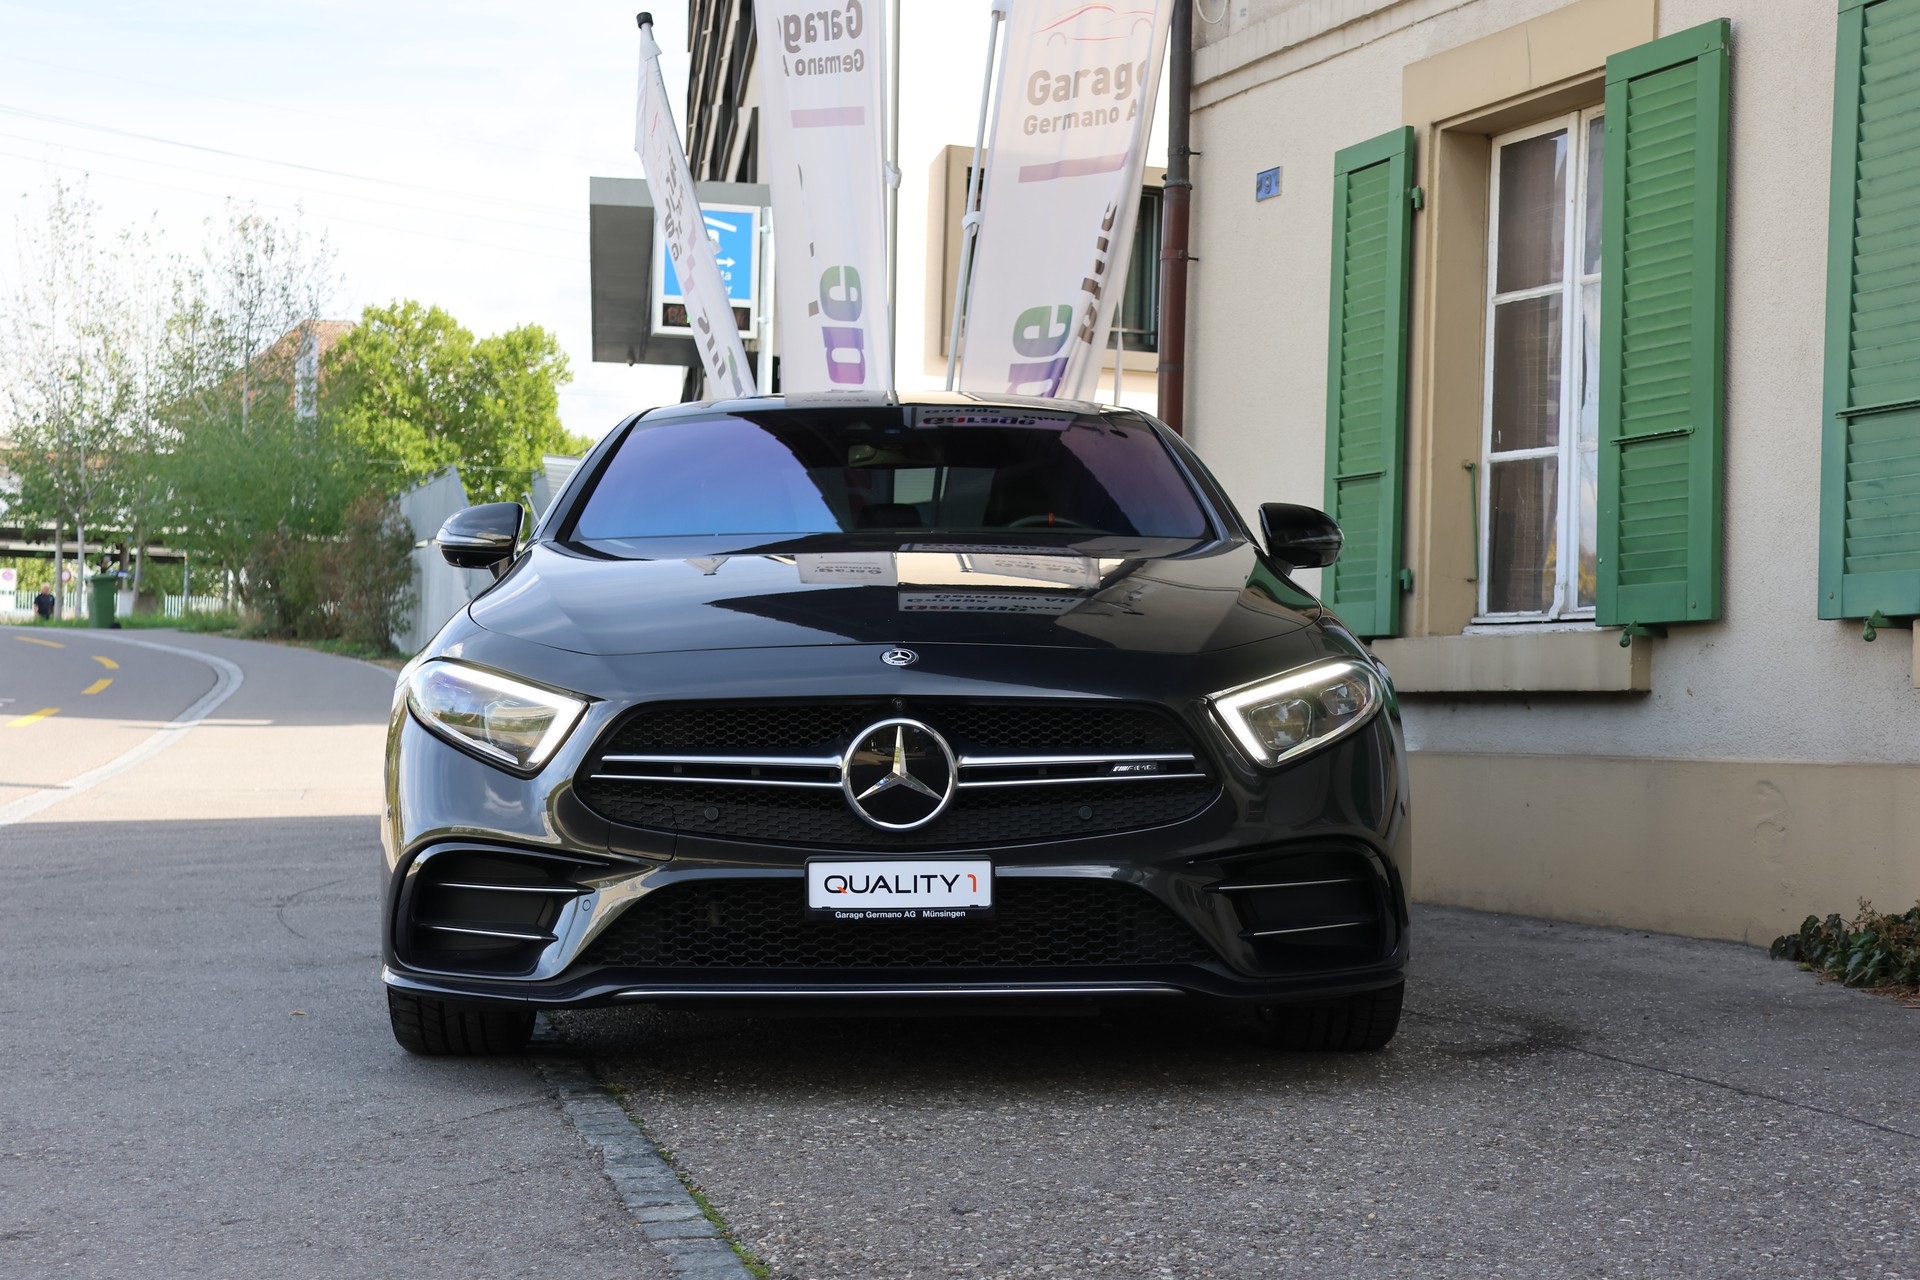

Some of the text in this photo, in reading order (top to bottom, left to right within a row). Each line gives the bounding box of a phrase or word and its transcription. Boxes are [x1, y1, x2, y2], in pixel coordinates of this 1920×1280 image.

[1023, 106, 1120, 136] Germano
[824, 874, 977, 894] QUALITY 1
[835, 910, 966, 920] Garage Germano AG Münsingen
